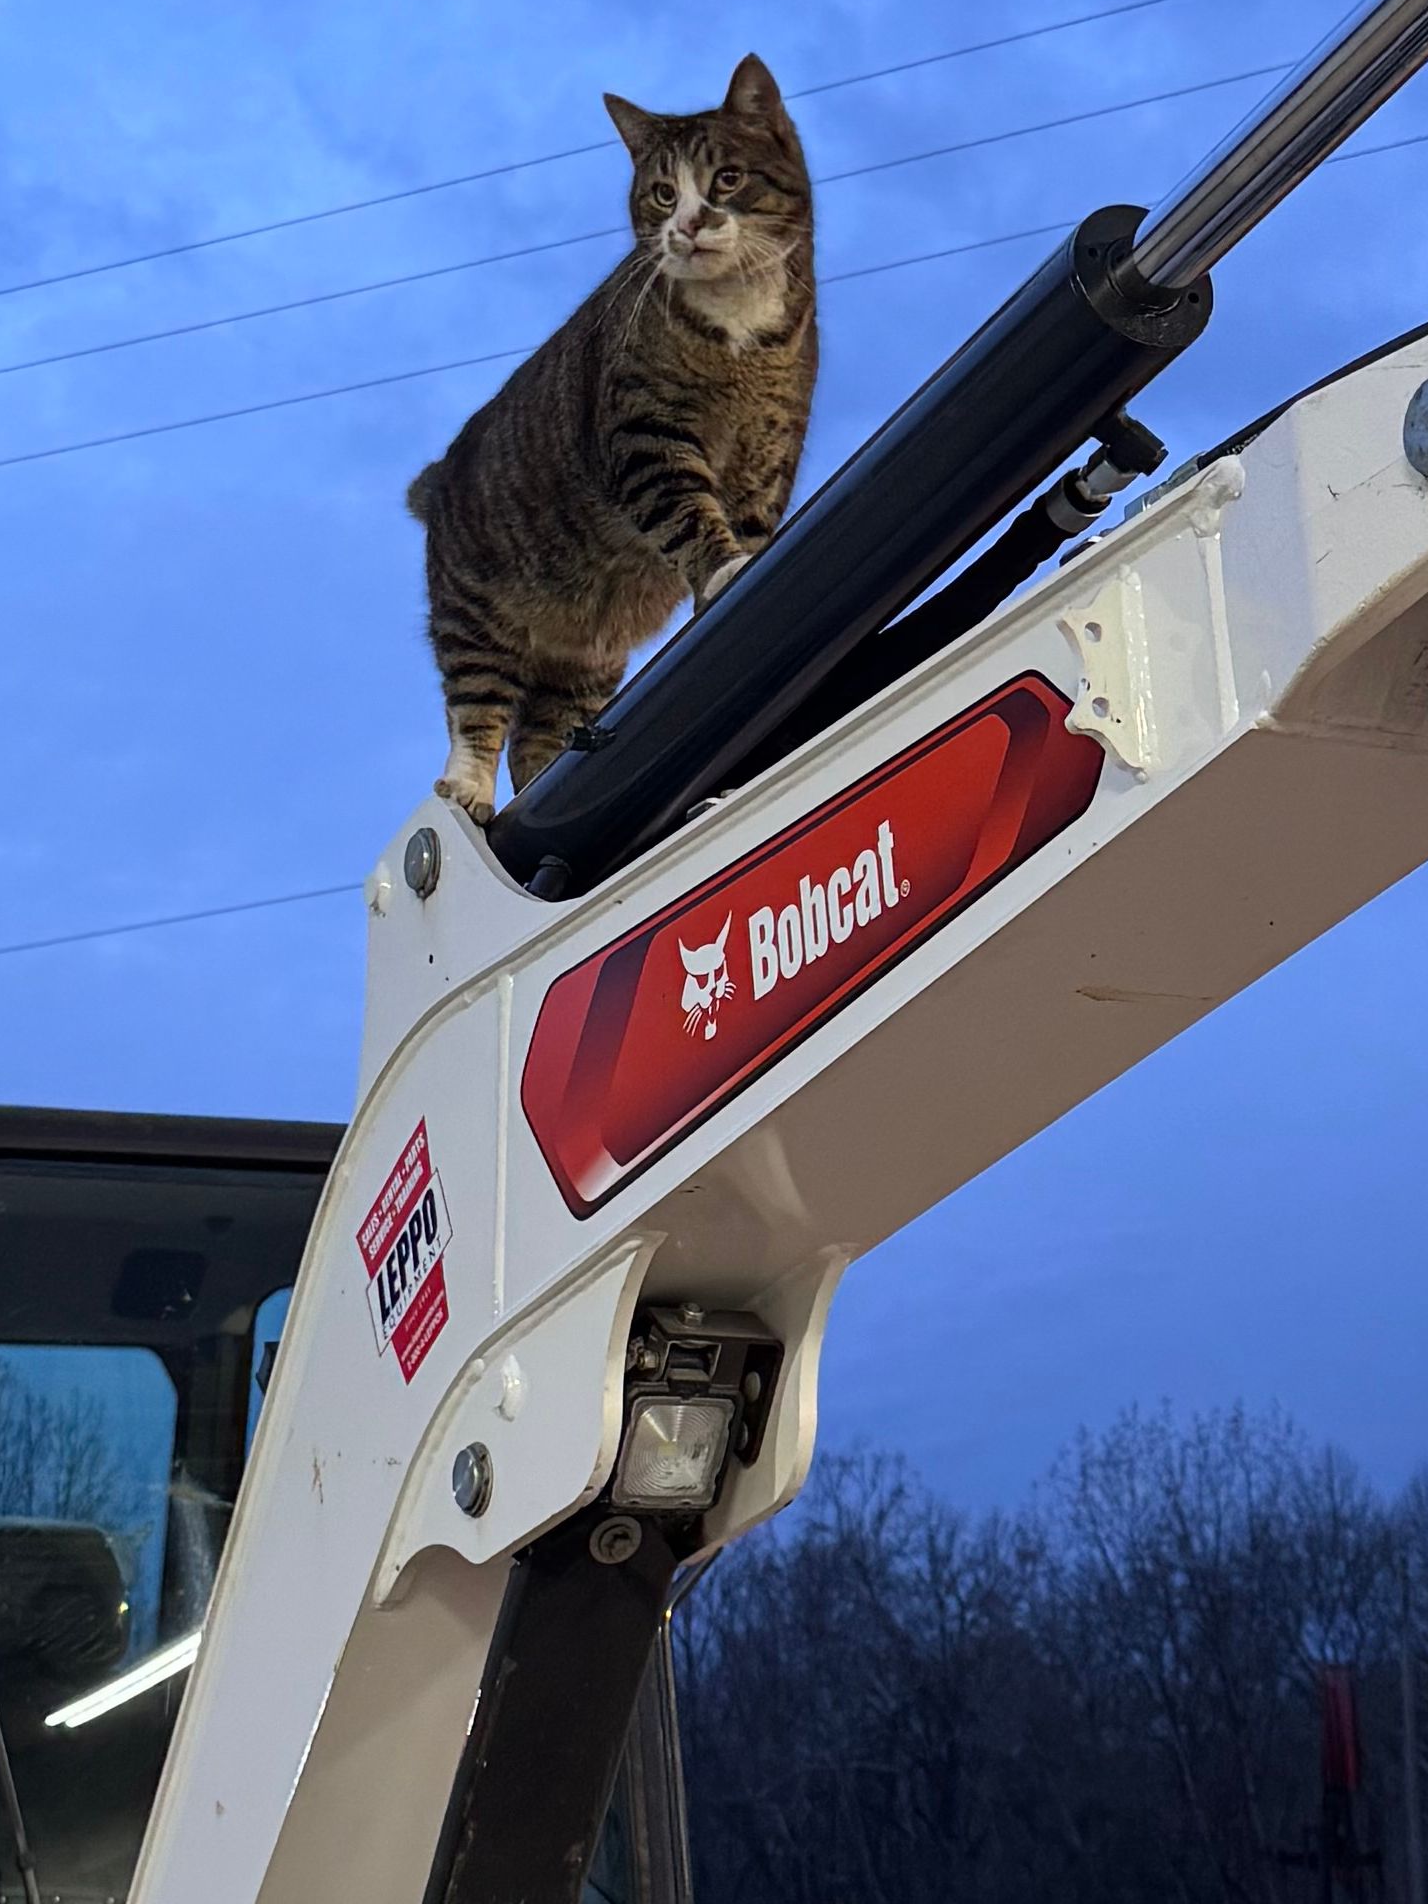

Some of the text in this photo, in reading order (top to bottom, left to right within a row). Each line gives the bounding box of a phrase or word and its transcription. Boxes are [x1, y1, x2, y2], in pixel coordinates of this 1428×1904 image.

[748, 819, 900, 1000] Bobcat
[377, 1188, 438, 1325] LEPPO
[383, 1234, 442, 1341] EQUIPMENT
